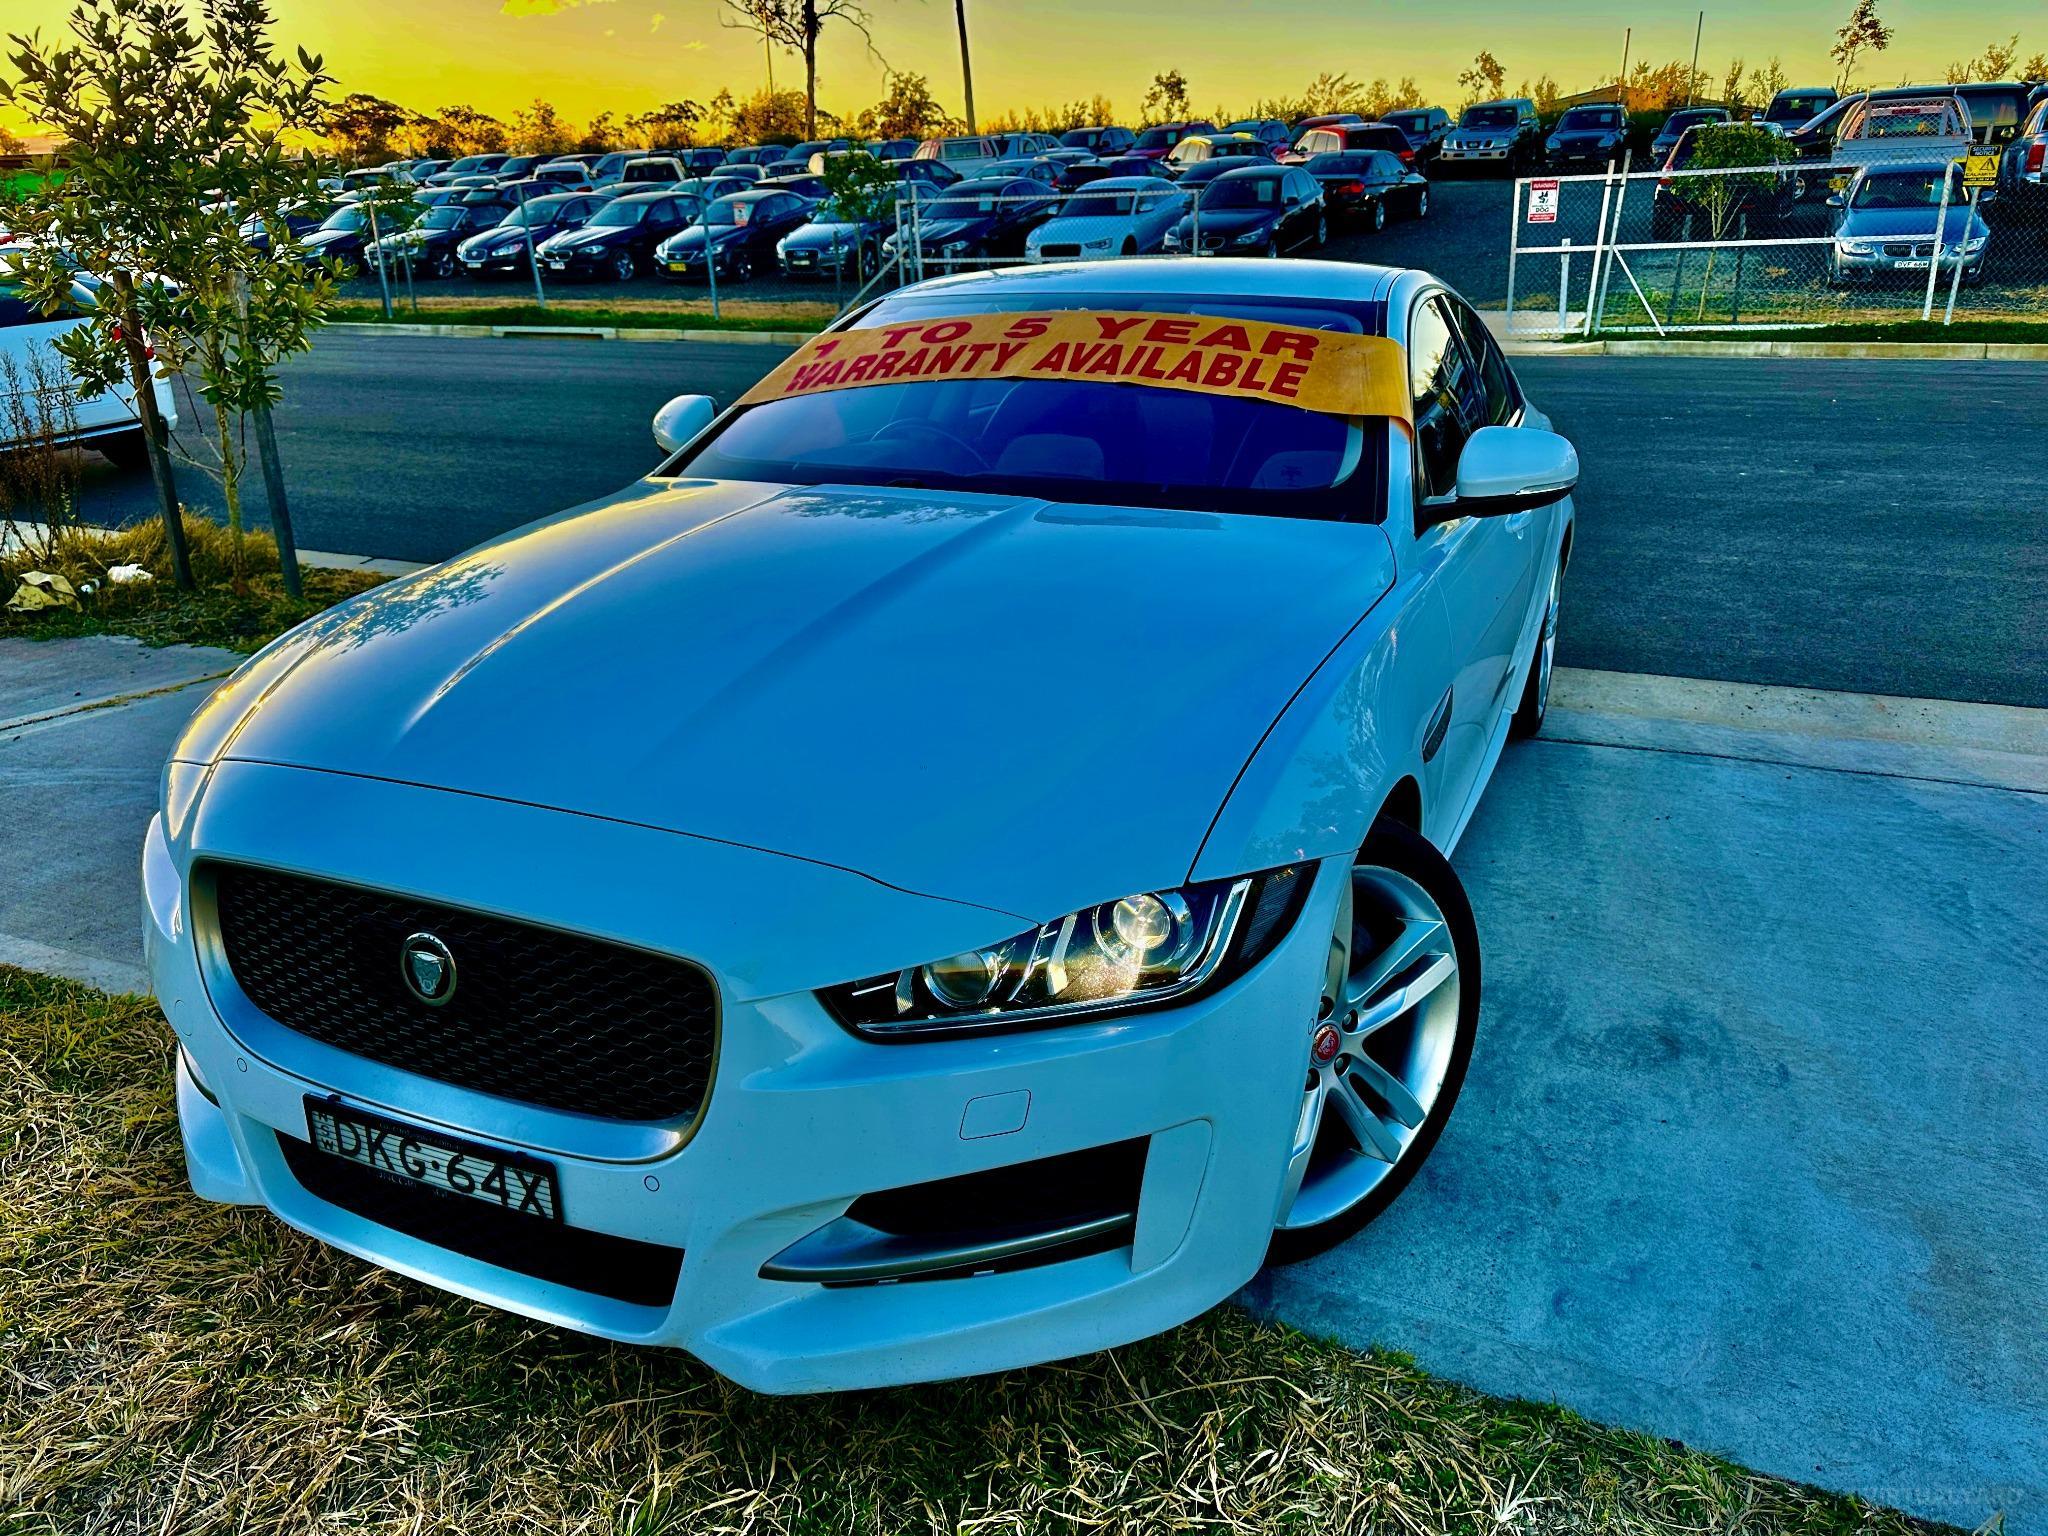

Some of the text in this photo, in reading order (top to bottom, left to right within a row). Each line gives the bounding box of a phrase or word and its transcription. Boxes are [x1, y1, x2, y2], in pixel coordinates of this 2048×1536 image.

[814, 317, 1320, 361] 1 TO 5 YEAR
[784, 341, 1309, 398] WARRANTY AVAILABLE
